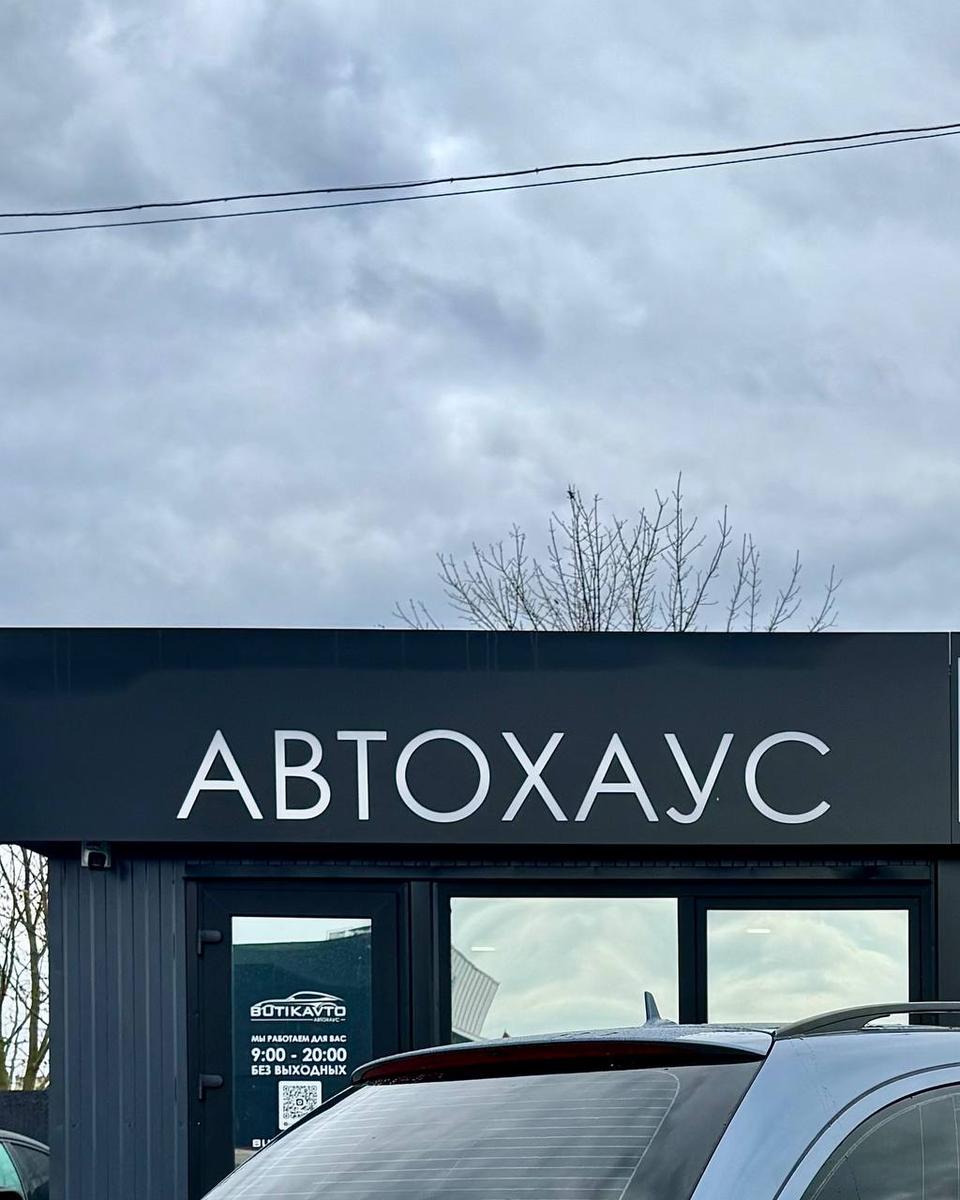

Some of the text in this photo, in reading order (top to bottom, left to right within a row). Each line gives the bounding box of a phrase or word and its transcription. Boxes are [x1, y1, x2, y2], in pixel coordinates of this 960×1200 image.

[176, 729, 831, 824] АВТОХАУС
[250, 1005, 346, 1017] BUTIKAVTO
[251, 1035, 347, 1043] МЫ РАБОТАЕМ ДЛЯ ВАС
[251, 1047, 286, 1062] 9:00
[302, 1047, 347, 1062] 20:00
[251, 1065, 347, 1076] БЕЗ ВЫХОДНЫХ
